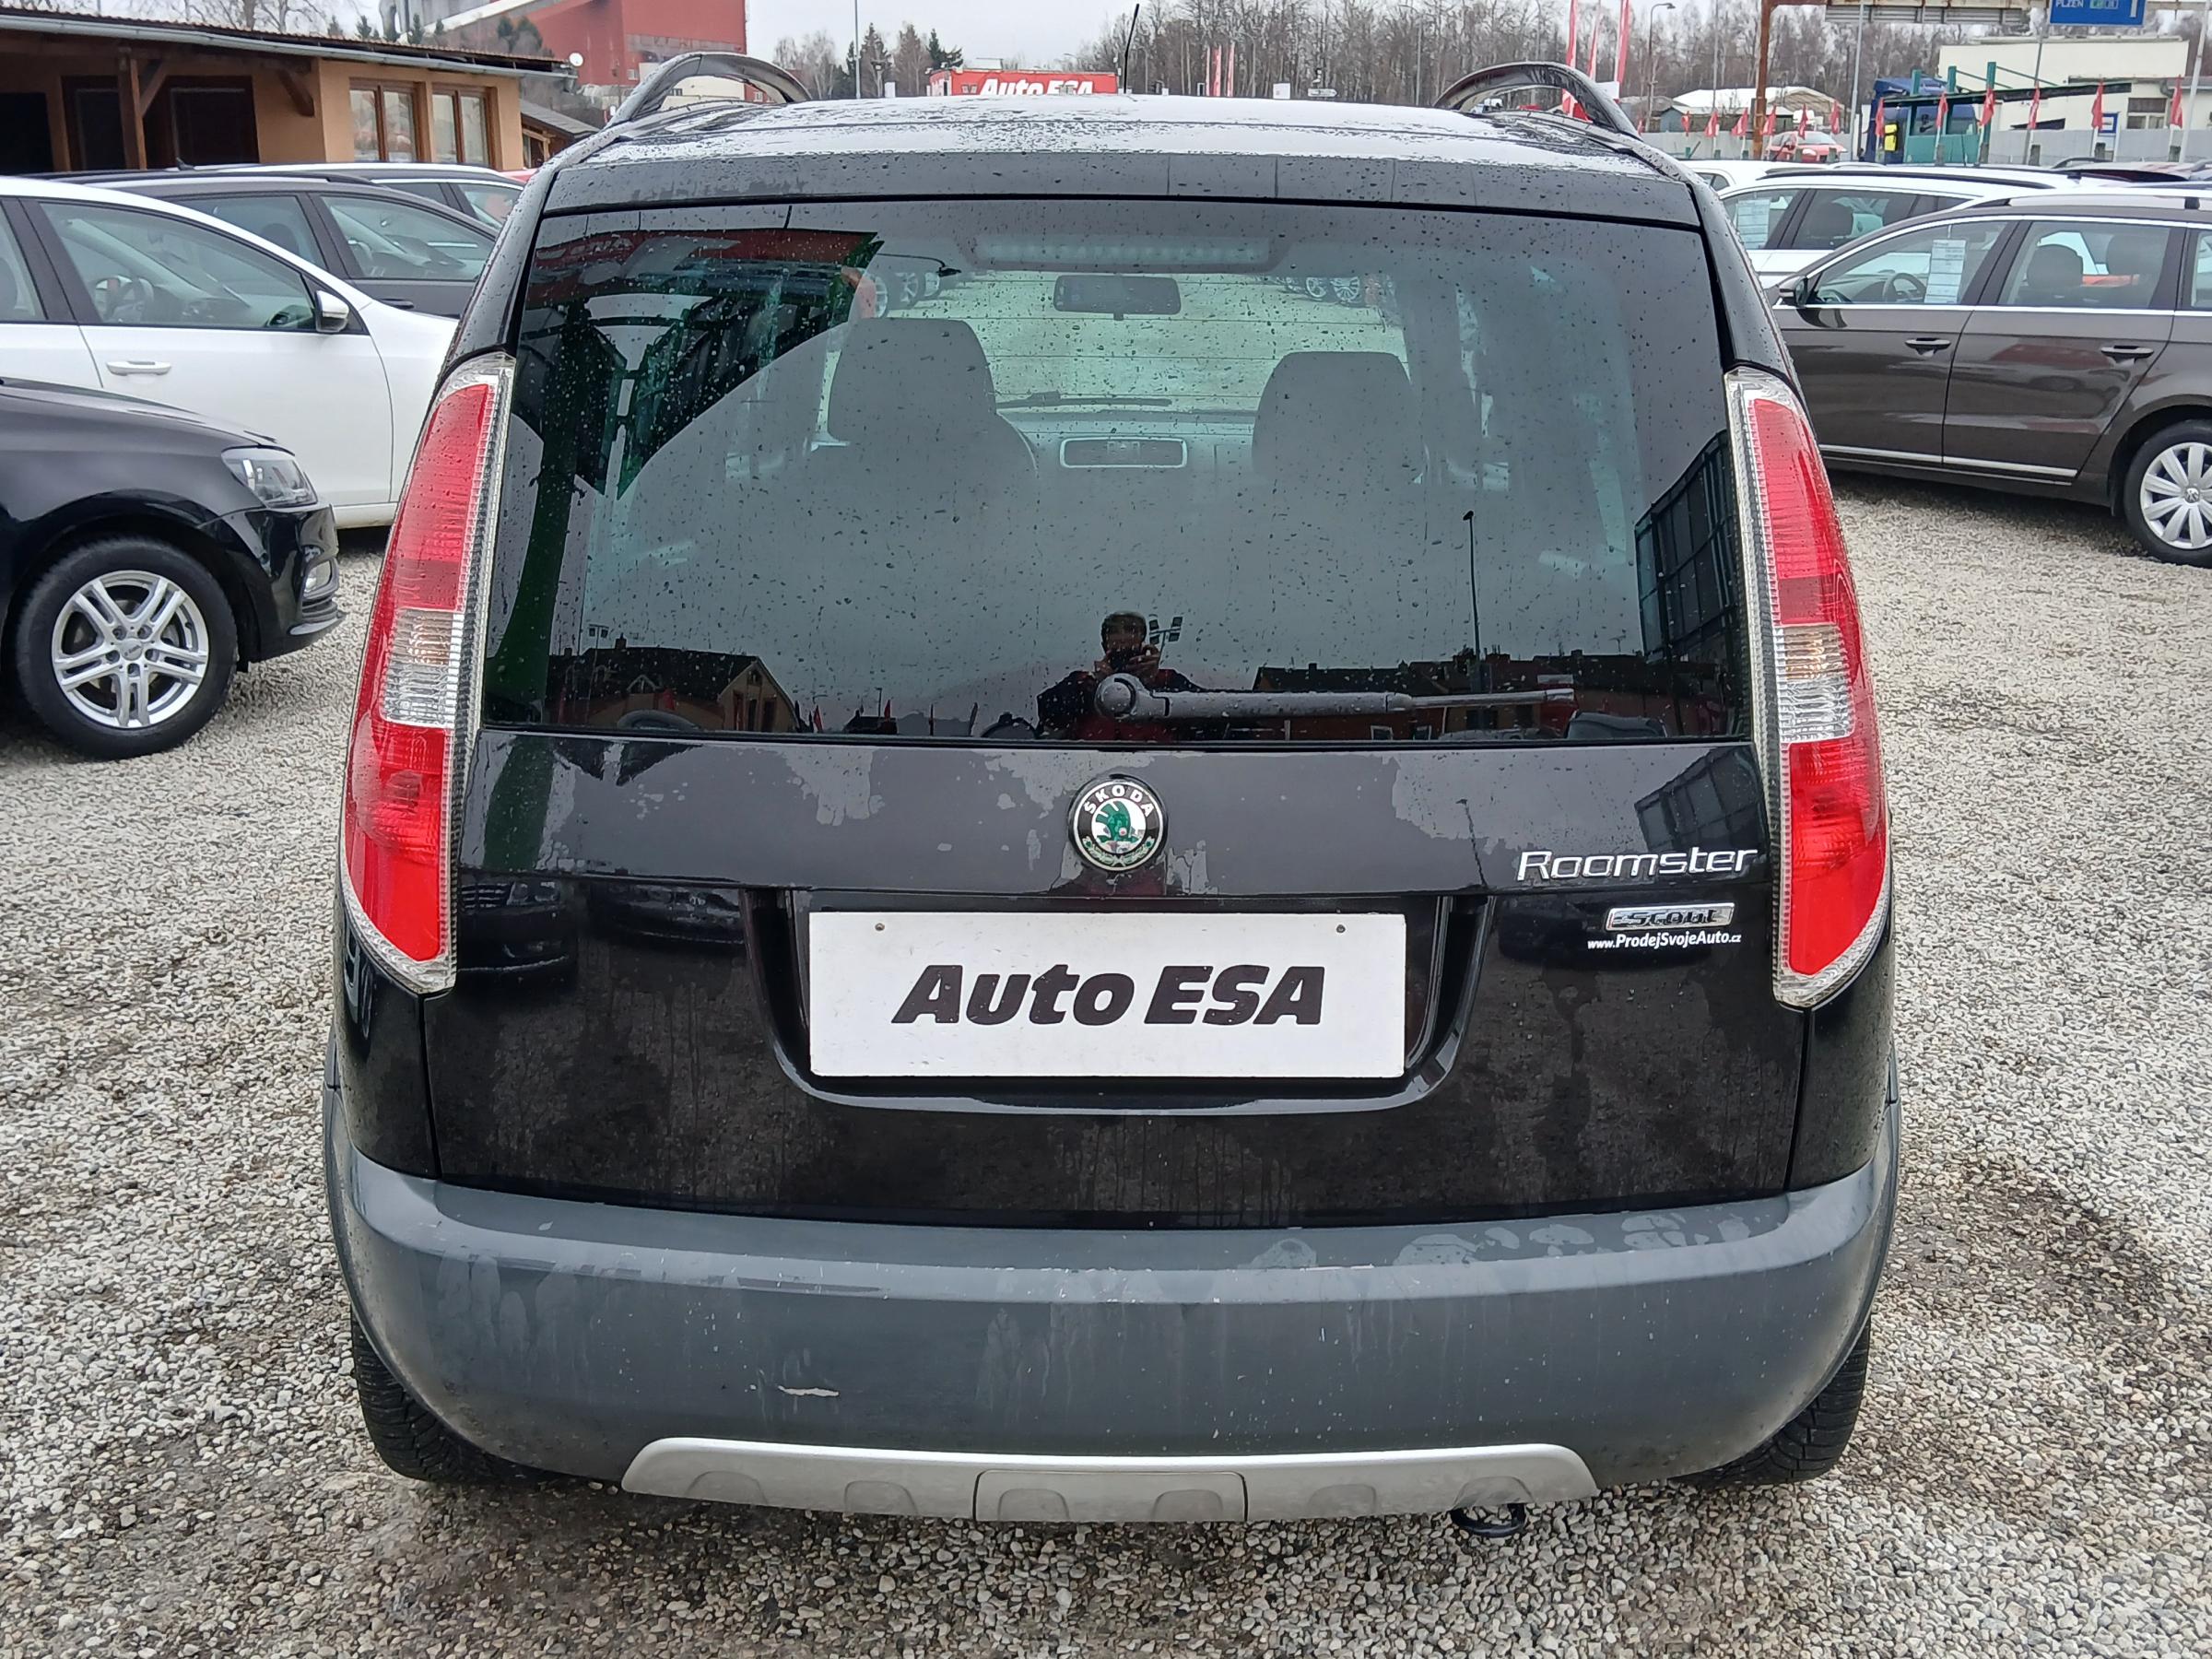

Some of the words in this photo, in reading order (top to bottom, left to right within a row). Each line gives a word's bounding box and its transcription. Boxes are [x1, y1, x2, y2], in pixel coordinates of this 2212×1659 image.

[980, 78, 1044, 95] Auto
[1517, 846, 1758, 881] Roomster
[1587, 930, 1742, 950] www.ProdejSvojeAuto.cz
[890, 964, 1135, 1025] Auto
[1143, 965, 1325, 1025] ESA
